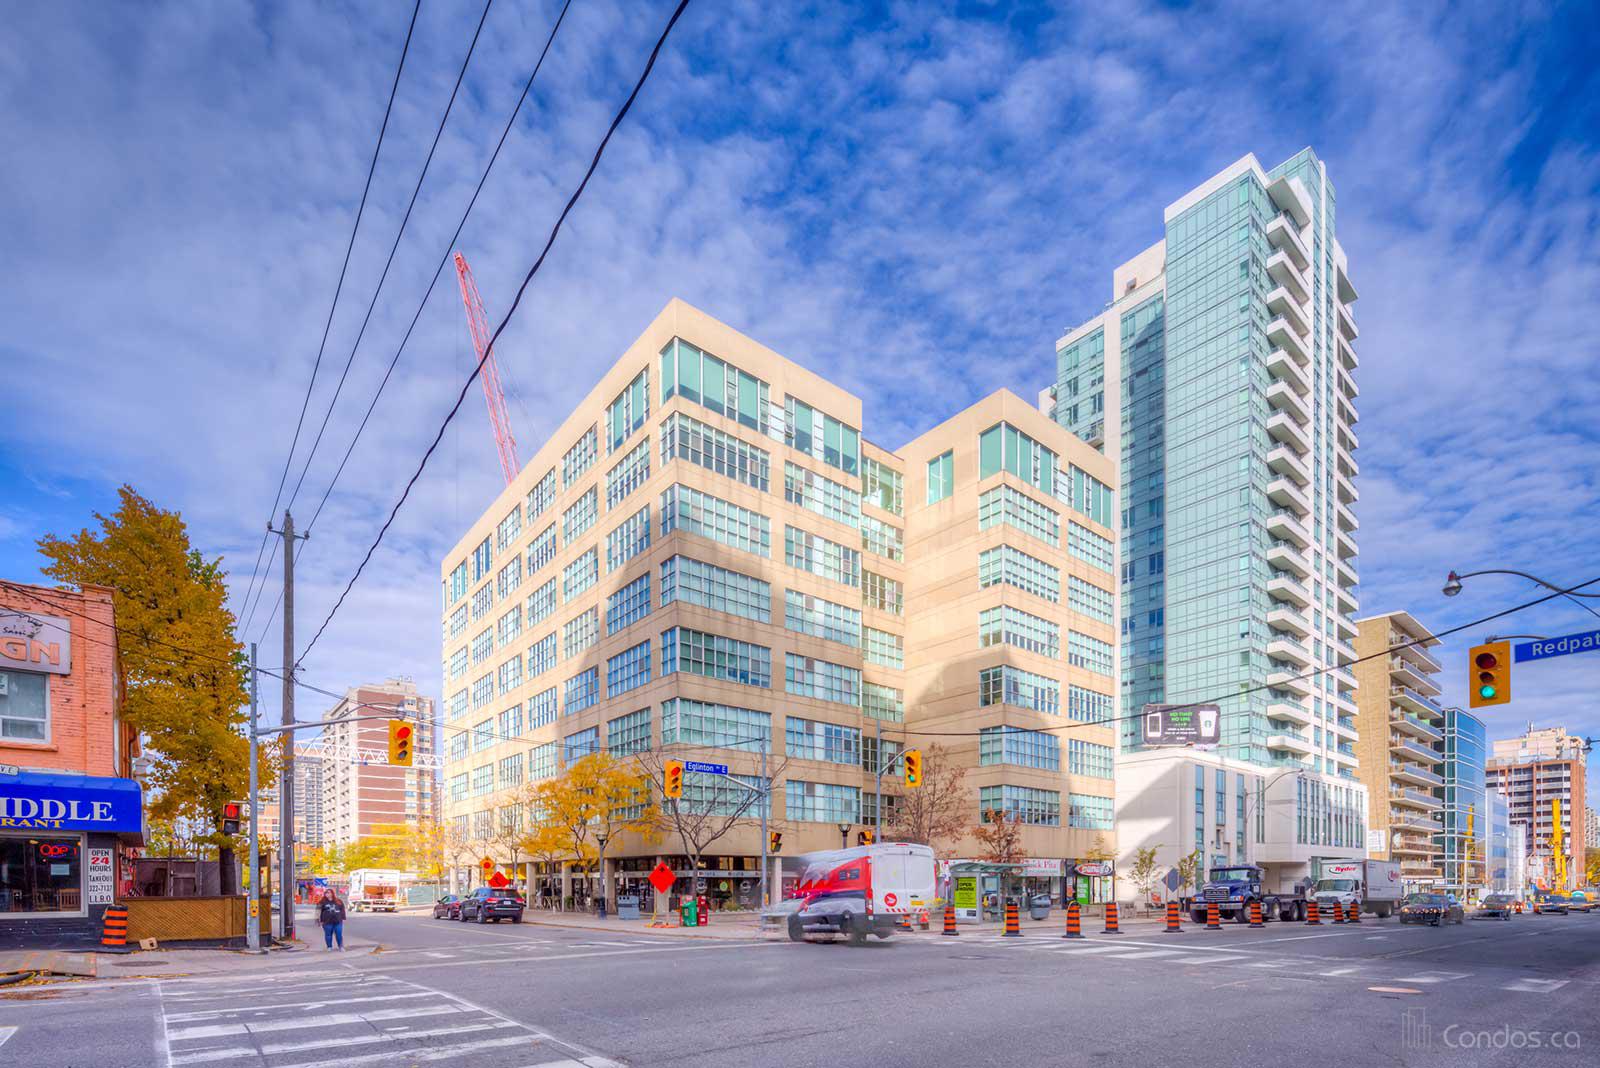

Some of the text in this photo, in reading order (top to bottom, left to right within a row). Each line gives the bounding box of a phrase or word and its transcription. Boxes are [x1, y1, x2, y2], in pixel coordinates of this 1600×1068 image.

[1532, 633, 1600, 656] Redpat
[688, 762, 714, 772] Eglinton
[91, 849, 110, 857] OPEN
[91, 856, 110, 865] 24
[89, 865, 112, 873] HOURS
